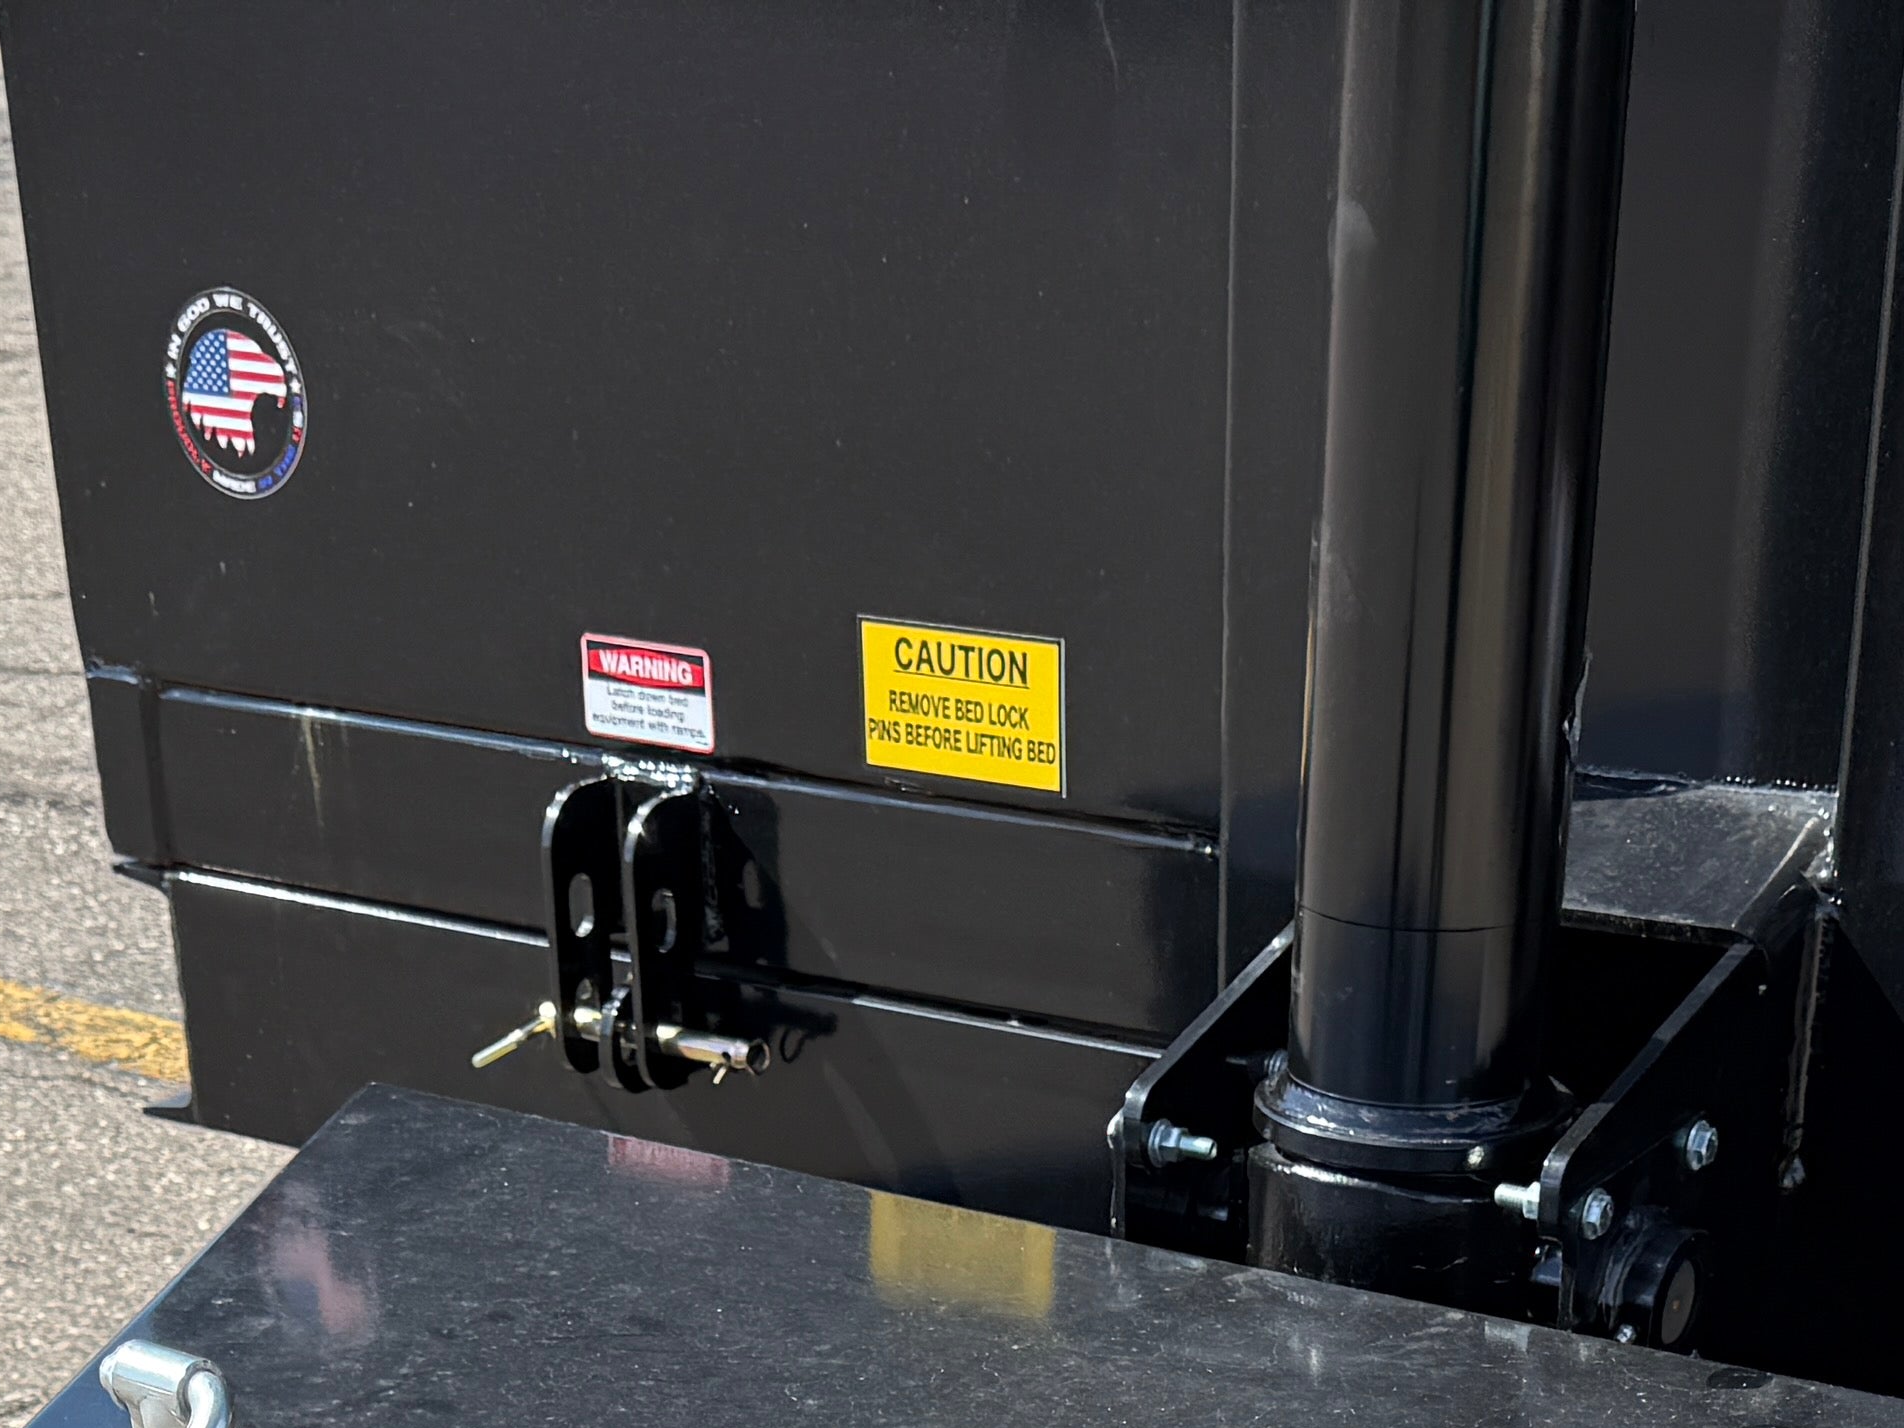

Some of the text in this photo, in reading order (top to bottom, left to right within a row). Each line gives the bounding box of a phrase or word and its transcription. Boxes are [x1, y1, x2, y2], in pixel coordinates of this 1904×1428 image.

[167, 294, 297, 374] IN GOD WE TRUST
[598, 649, 693, 685] WARNING
[894, 636, 1027, 685] CAUTION
[888, 689, 1029, 731] REMOVE BED LOCK
[868, 717, 1056, 765] PINS BEFORE LIFTING BED
